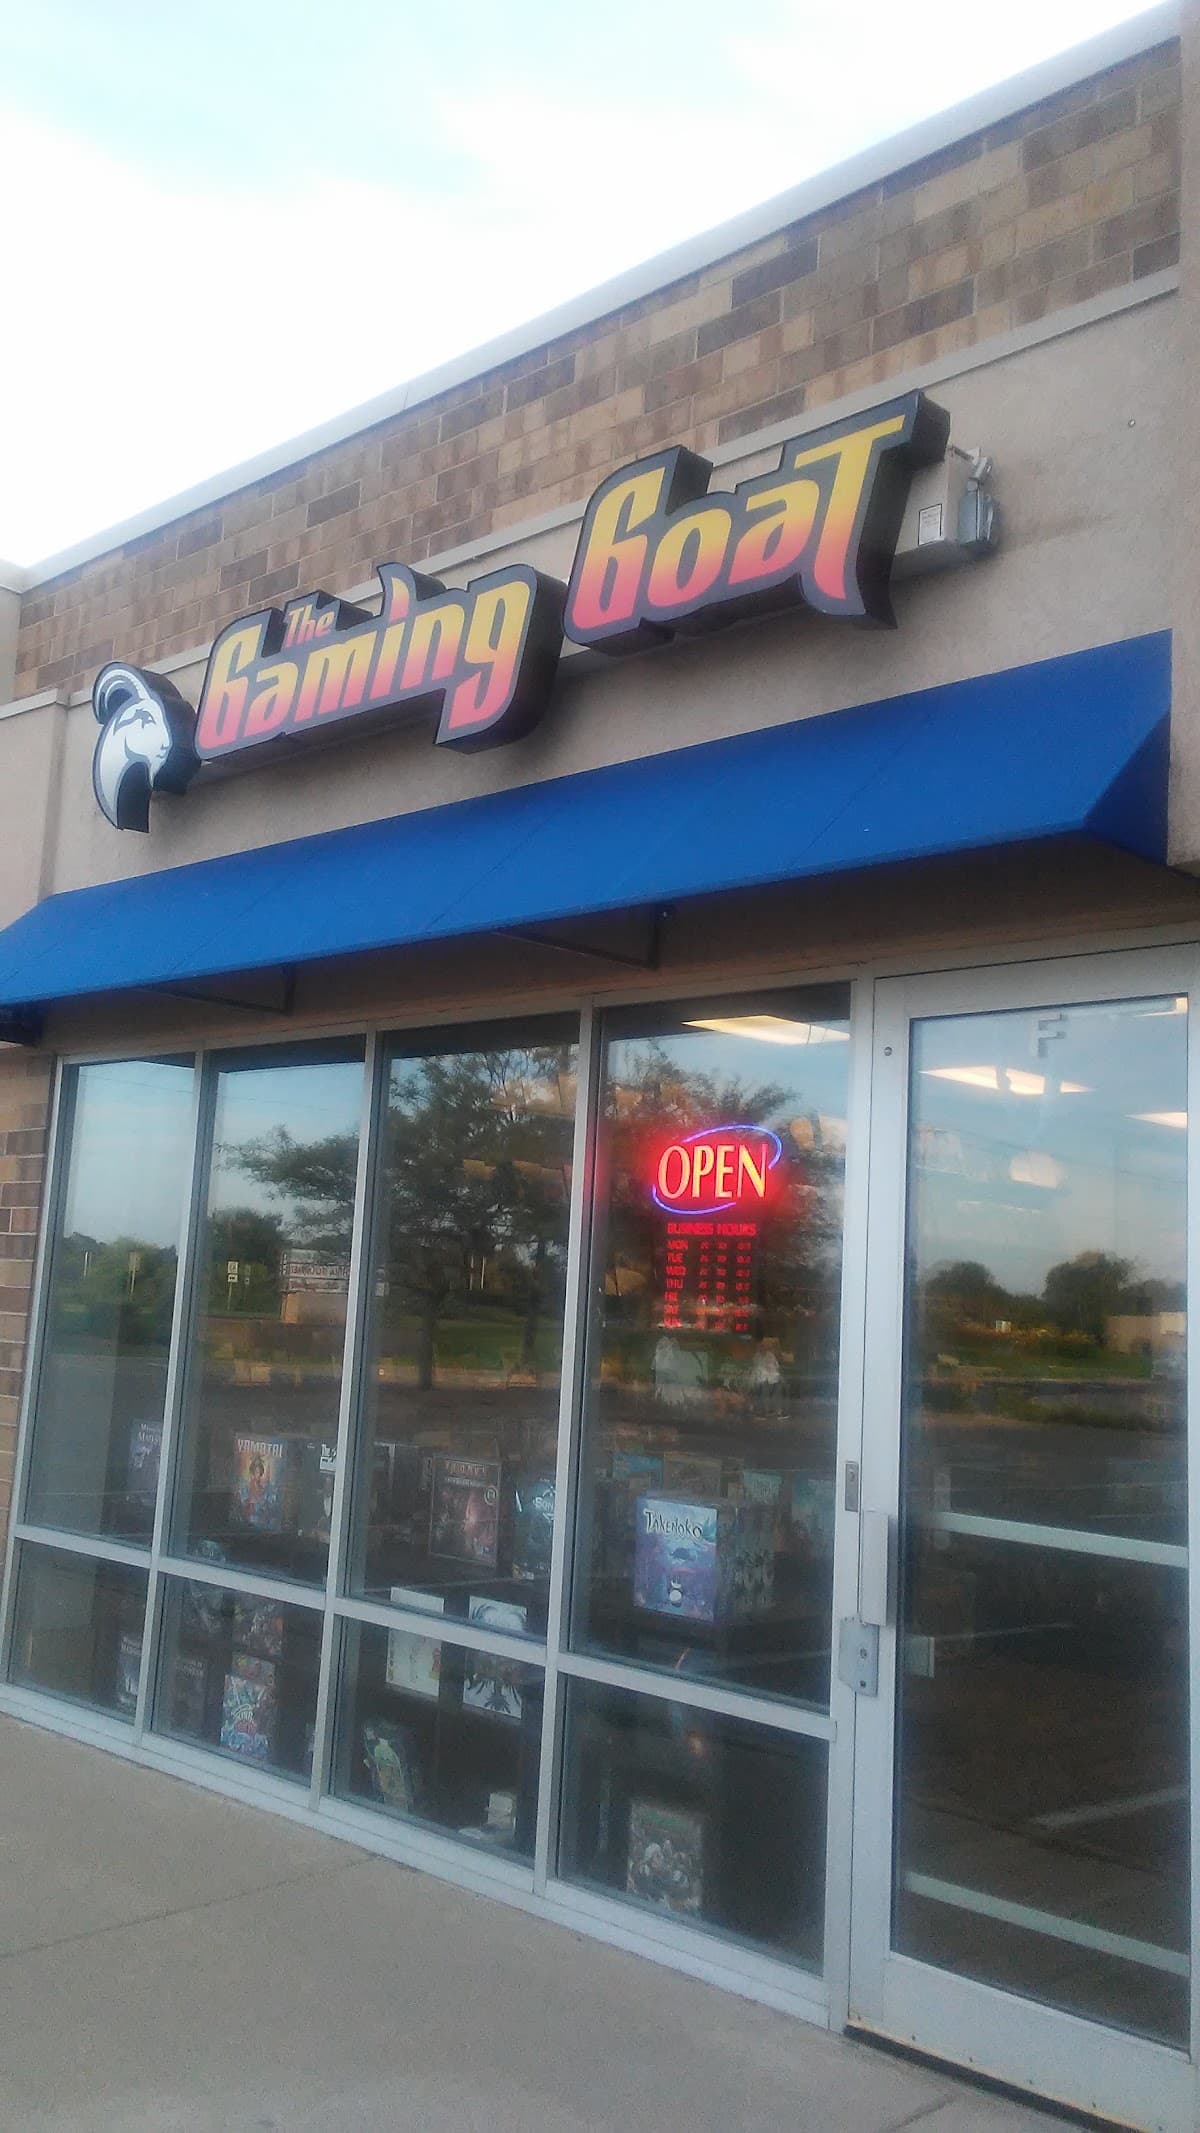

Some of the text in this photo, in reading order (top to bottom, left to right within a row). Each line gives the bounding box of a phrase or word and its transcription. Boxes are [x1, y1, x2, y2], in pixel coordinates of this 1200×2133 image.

[284, 605, 334, 648] The
[200, 577, 532, 750] Gaming
[657, 1143, 768, 1199] OPEN
[717, 1223, 757, 1236] HOURS
[237, 1439, 283, 1458] YAMATAI
